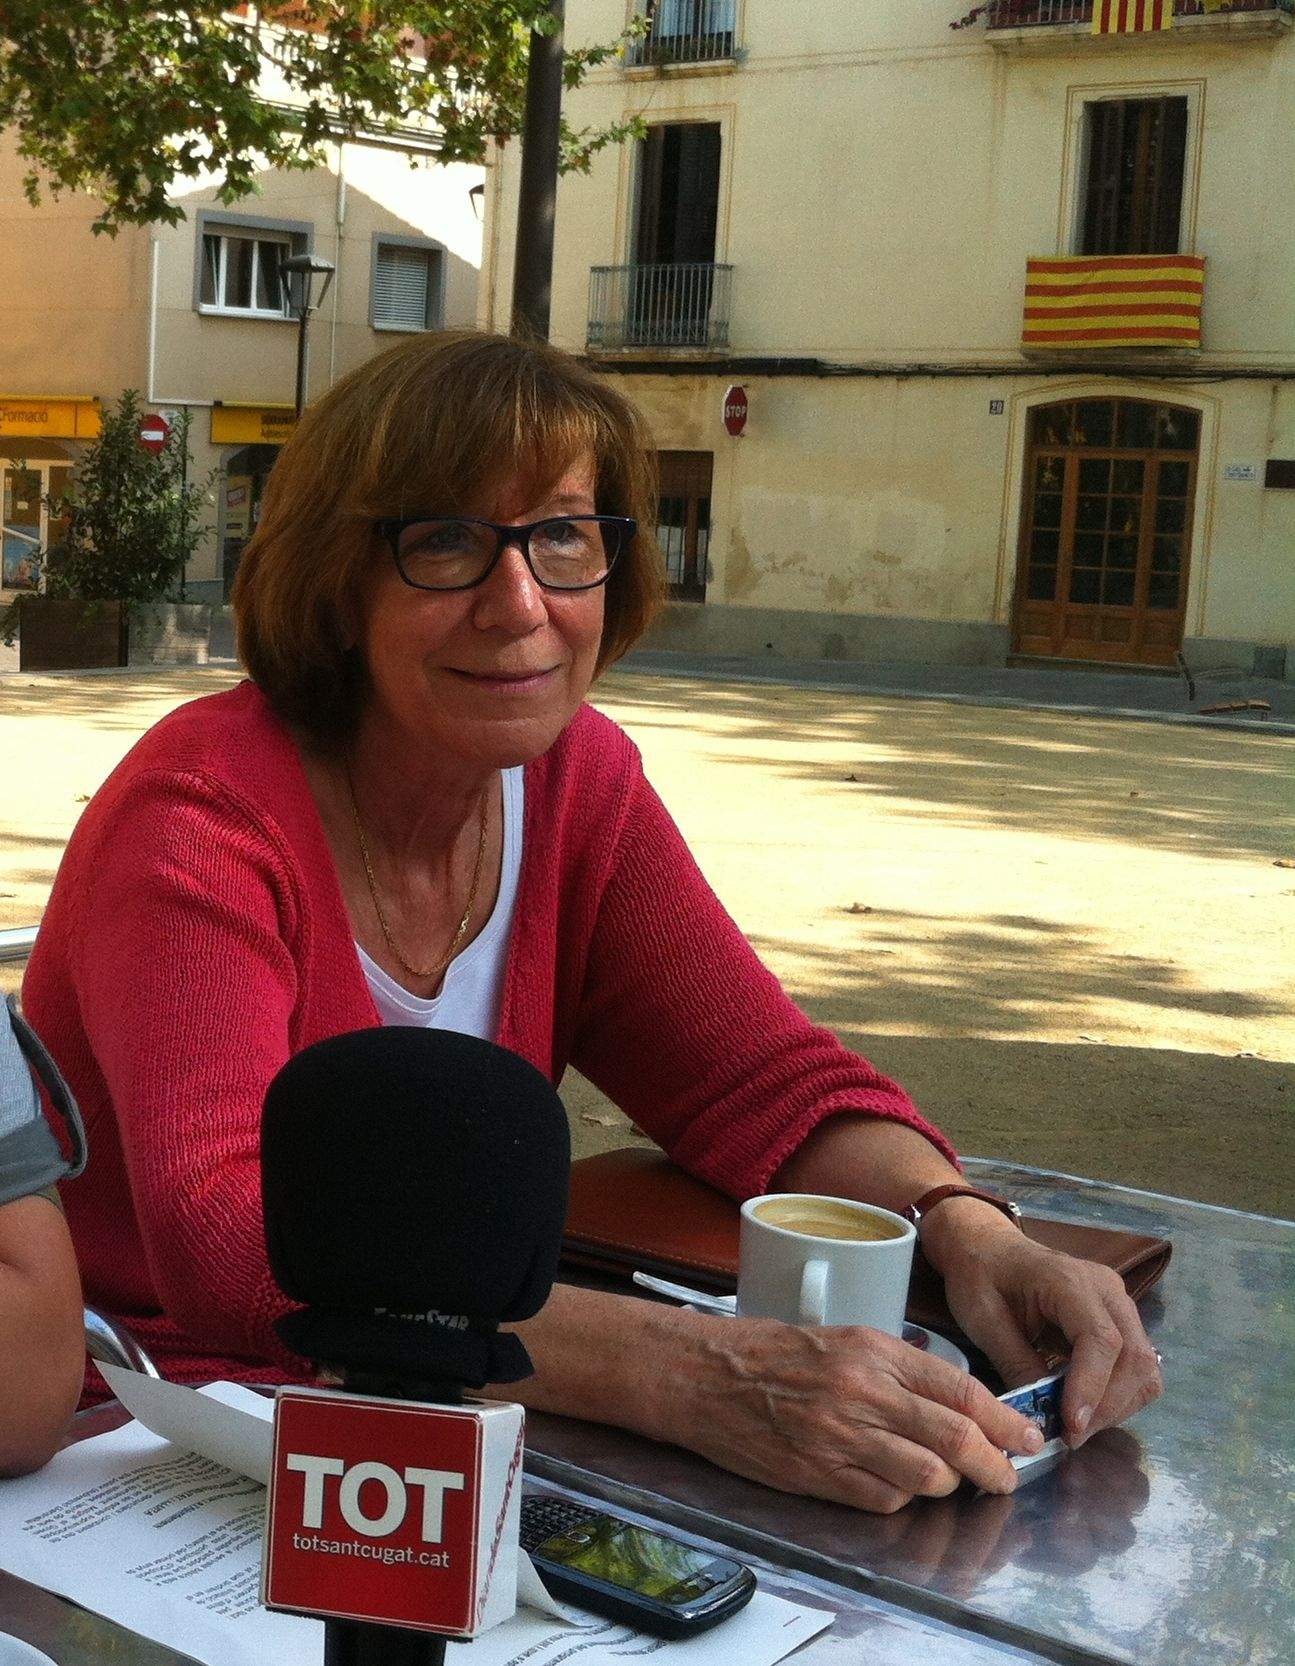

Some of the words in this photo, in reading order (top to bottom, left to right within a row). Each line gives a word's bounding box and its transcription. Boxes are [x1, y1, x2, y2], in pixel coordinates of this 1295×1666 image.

[725, 404, 747, 418] STOP
[286, 1453, 464, 1544] TOT
[293, 1532, 450, 1568] totsantcugat.cat
